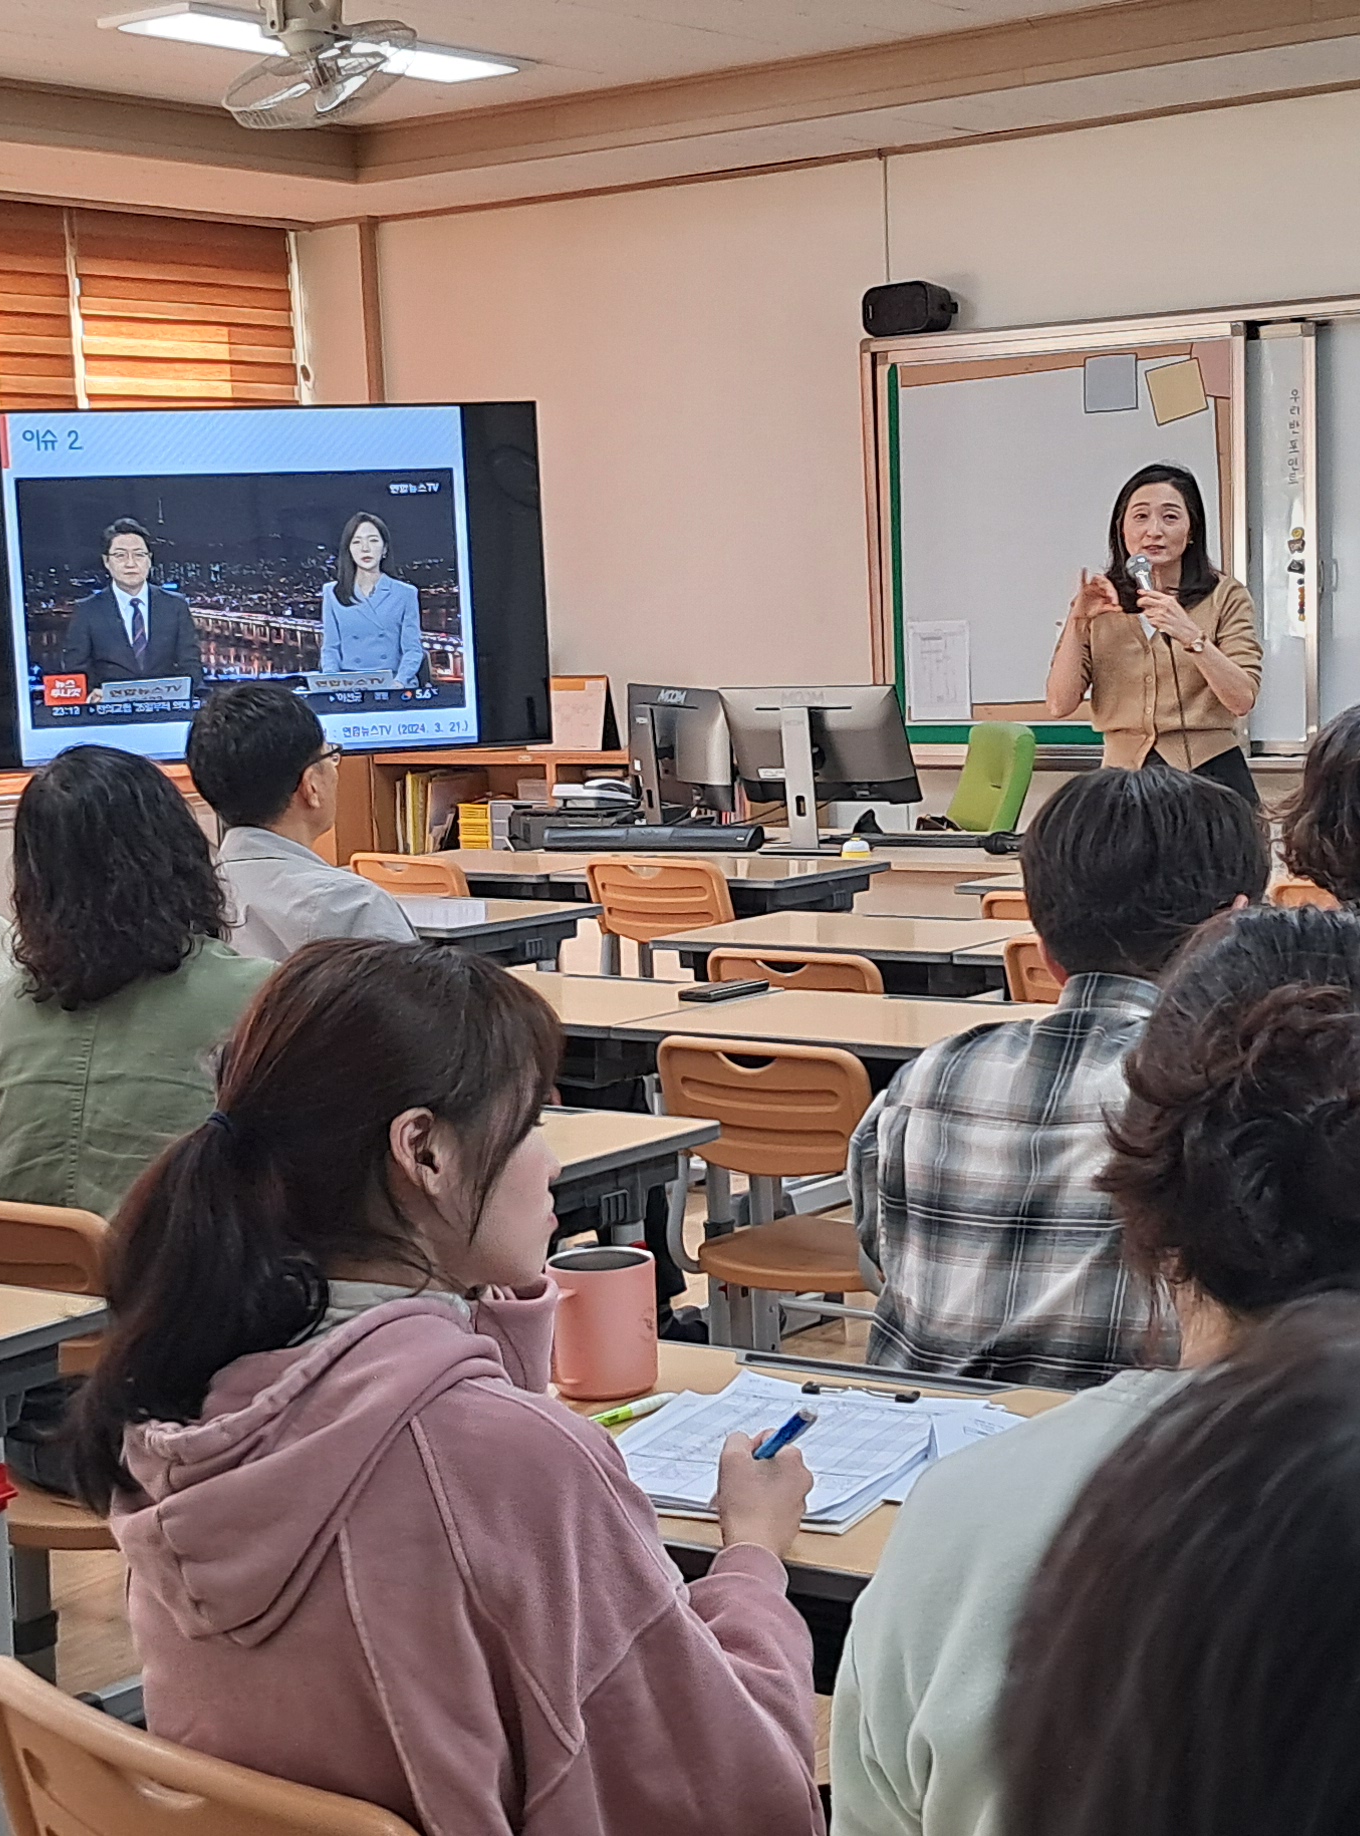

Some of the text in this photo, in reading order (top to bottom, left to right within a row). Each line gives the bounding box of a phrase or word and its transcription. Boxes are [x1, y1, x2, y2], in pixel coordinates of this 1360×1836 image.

[22, 429, 84, 451] 이슈 2
[342, 725, 392, 738] 연합뉴스TV
